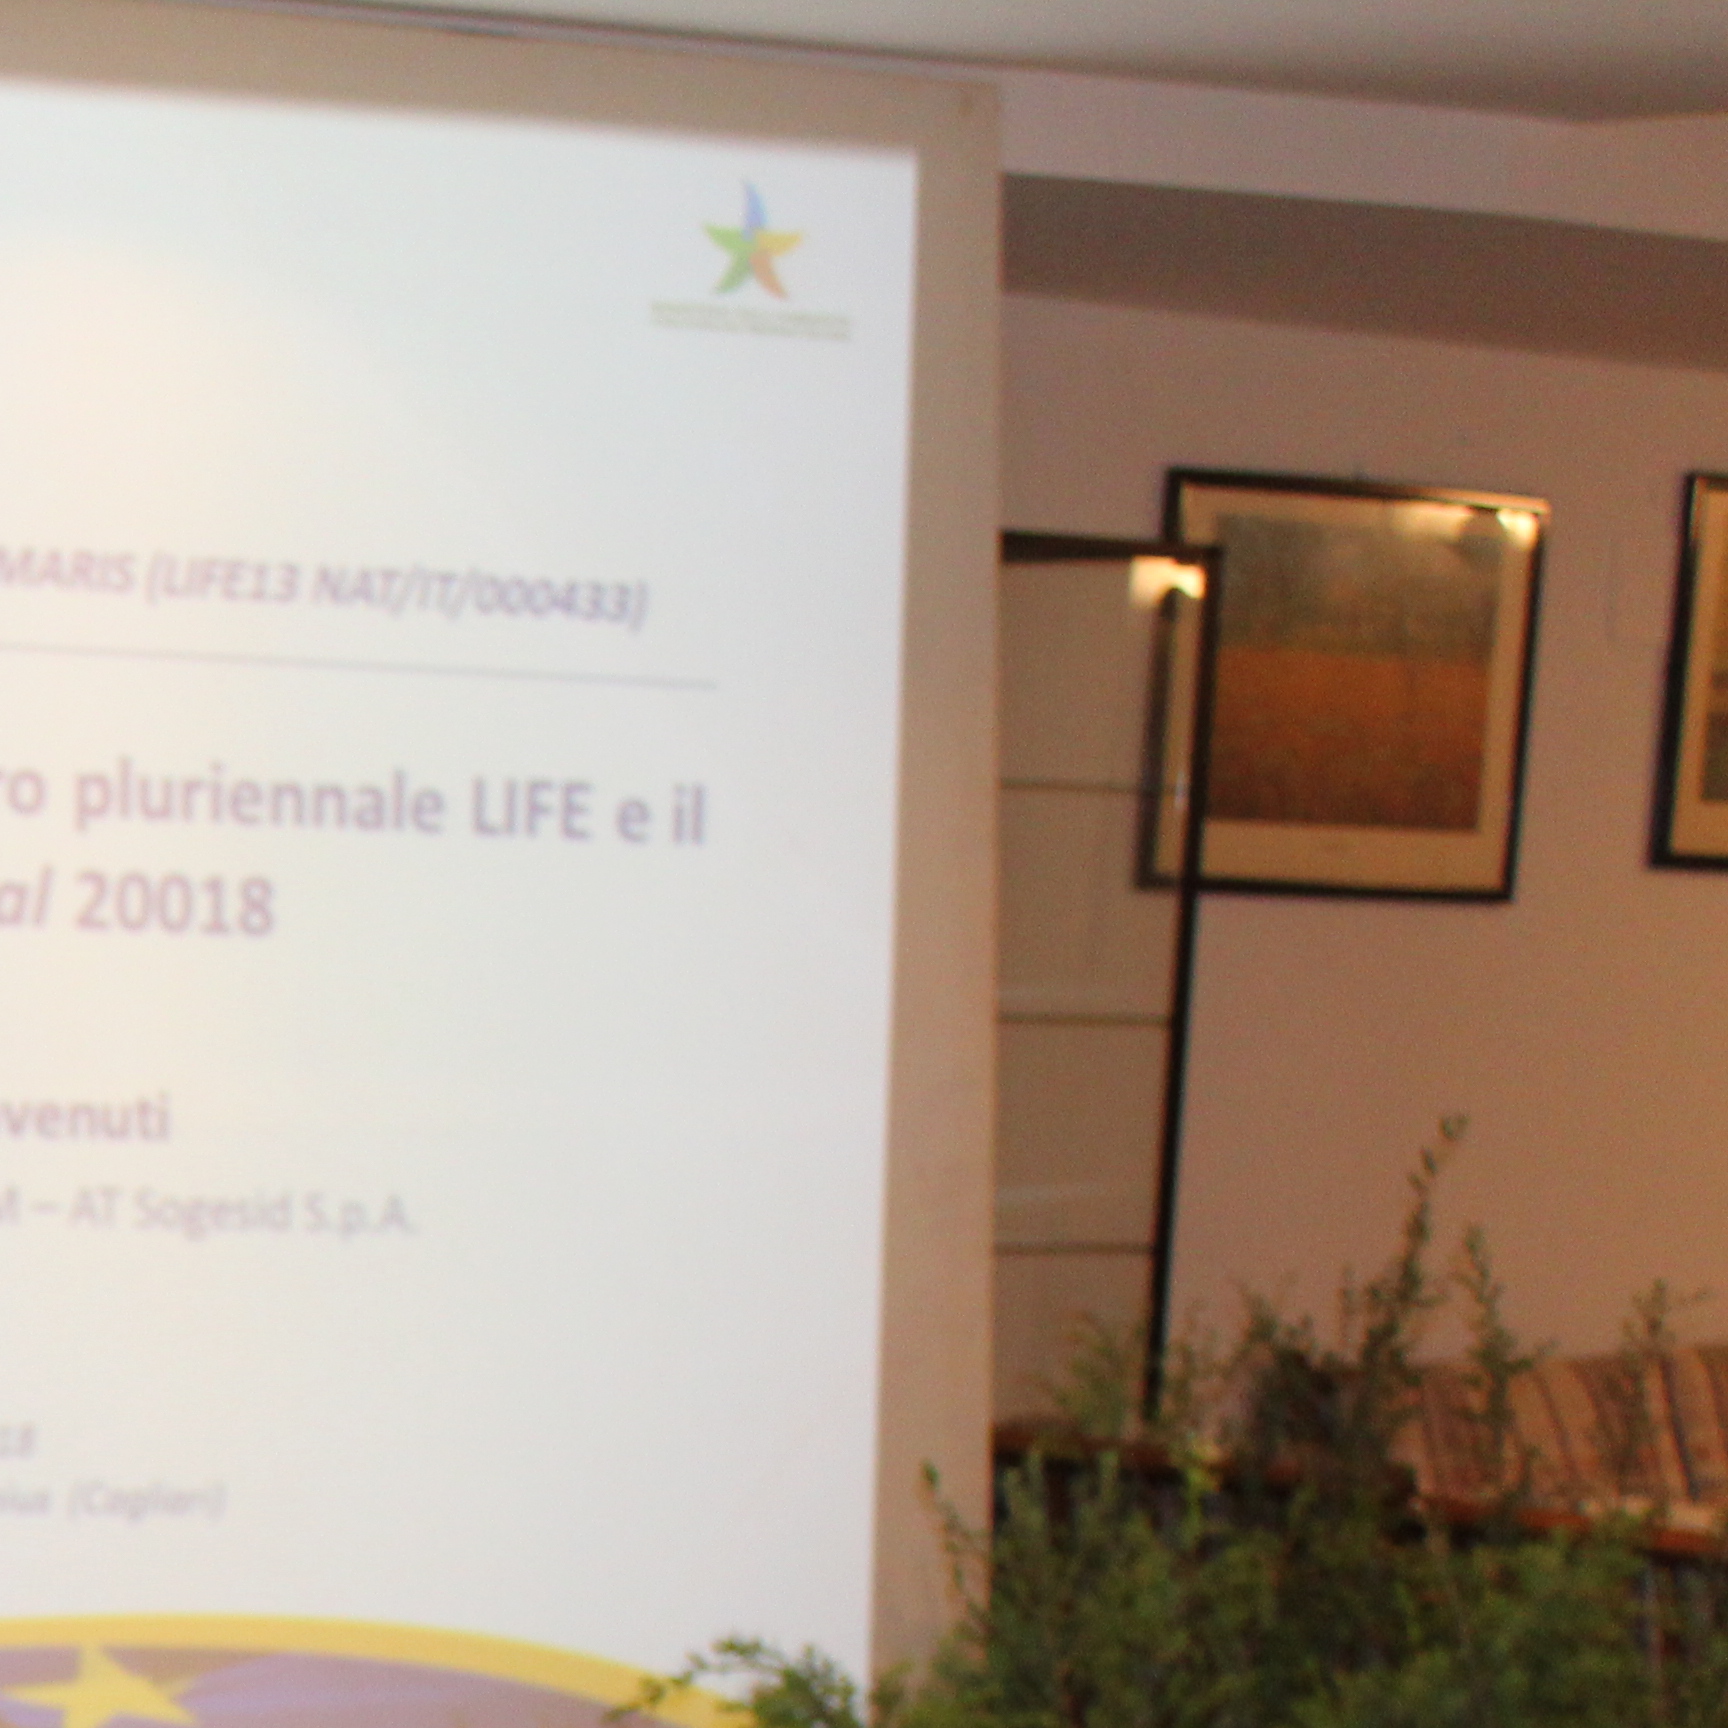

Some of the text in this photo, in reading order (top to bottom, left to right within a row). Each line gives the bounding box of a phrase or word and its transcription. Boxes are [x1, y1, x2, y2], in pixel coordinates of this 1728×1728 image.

[145, 552, 302, 604] (LIFE13
[74, 756, 447, 835] pluriennale
[471, 777, 592, 841] LIFE
[615, 797, 652, 845] e
[671, 784, 706, 845] il
[75, 868, 276, 938] 20018
